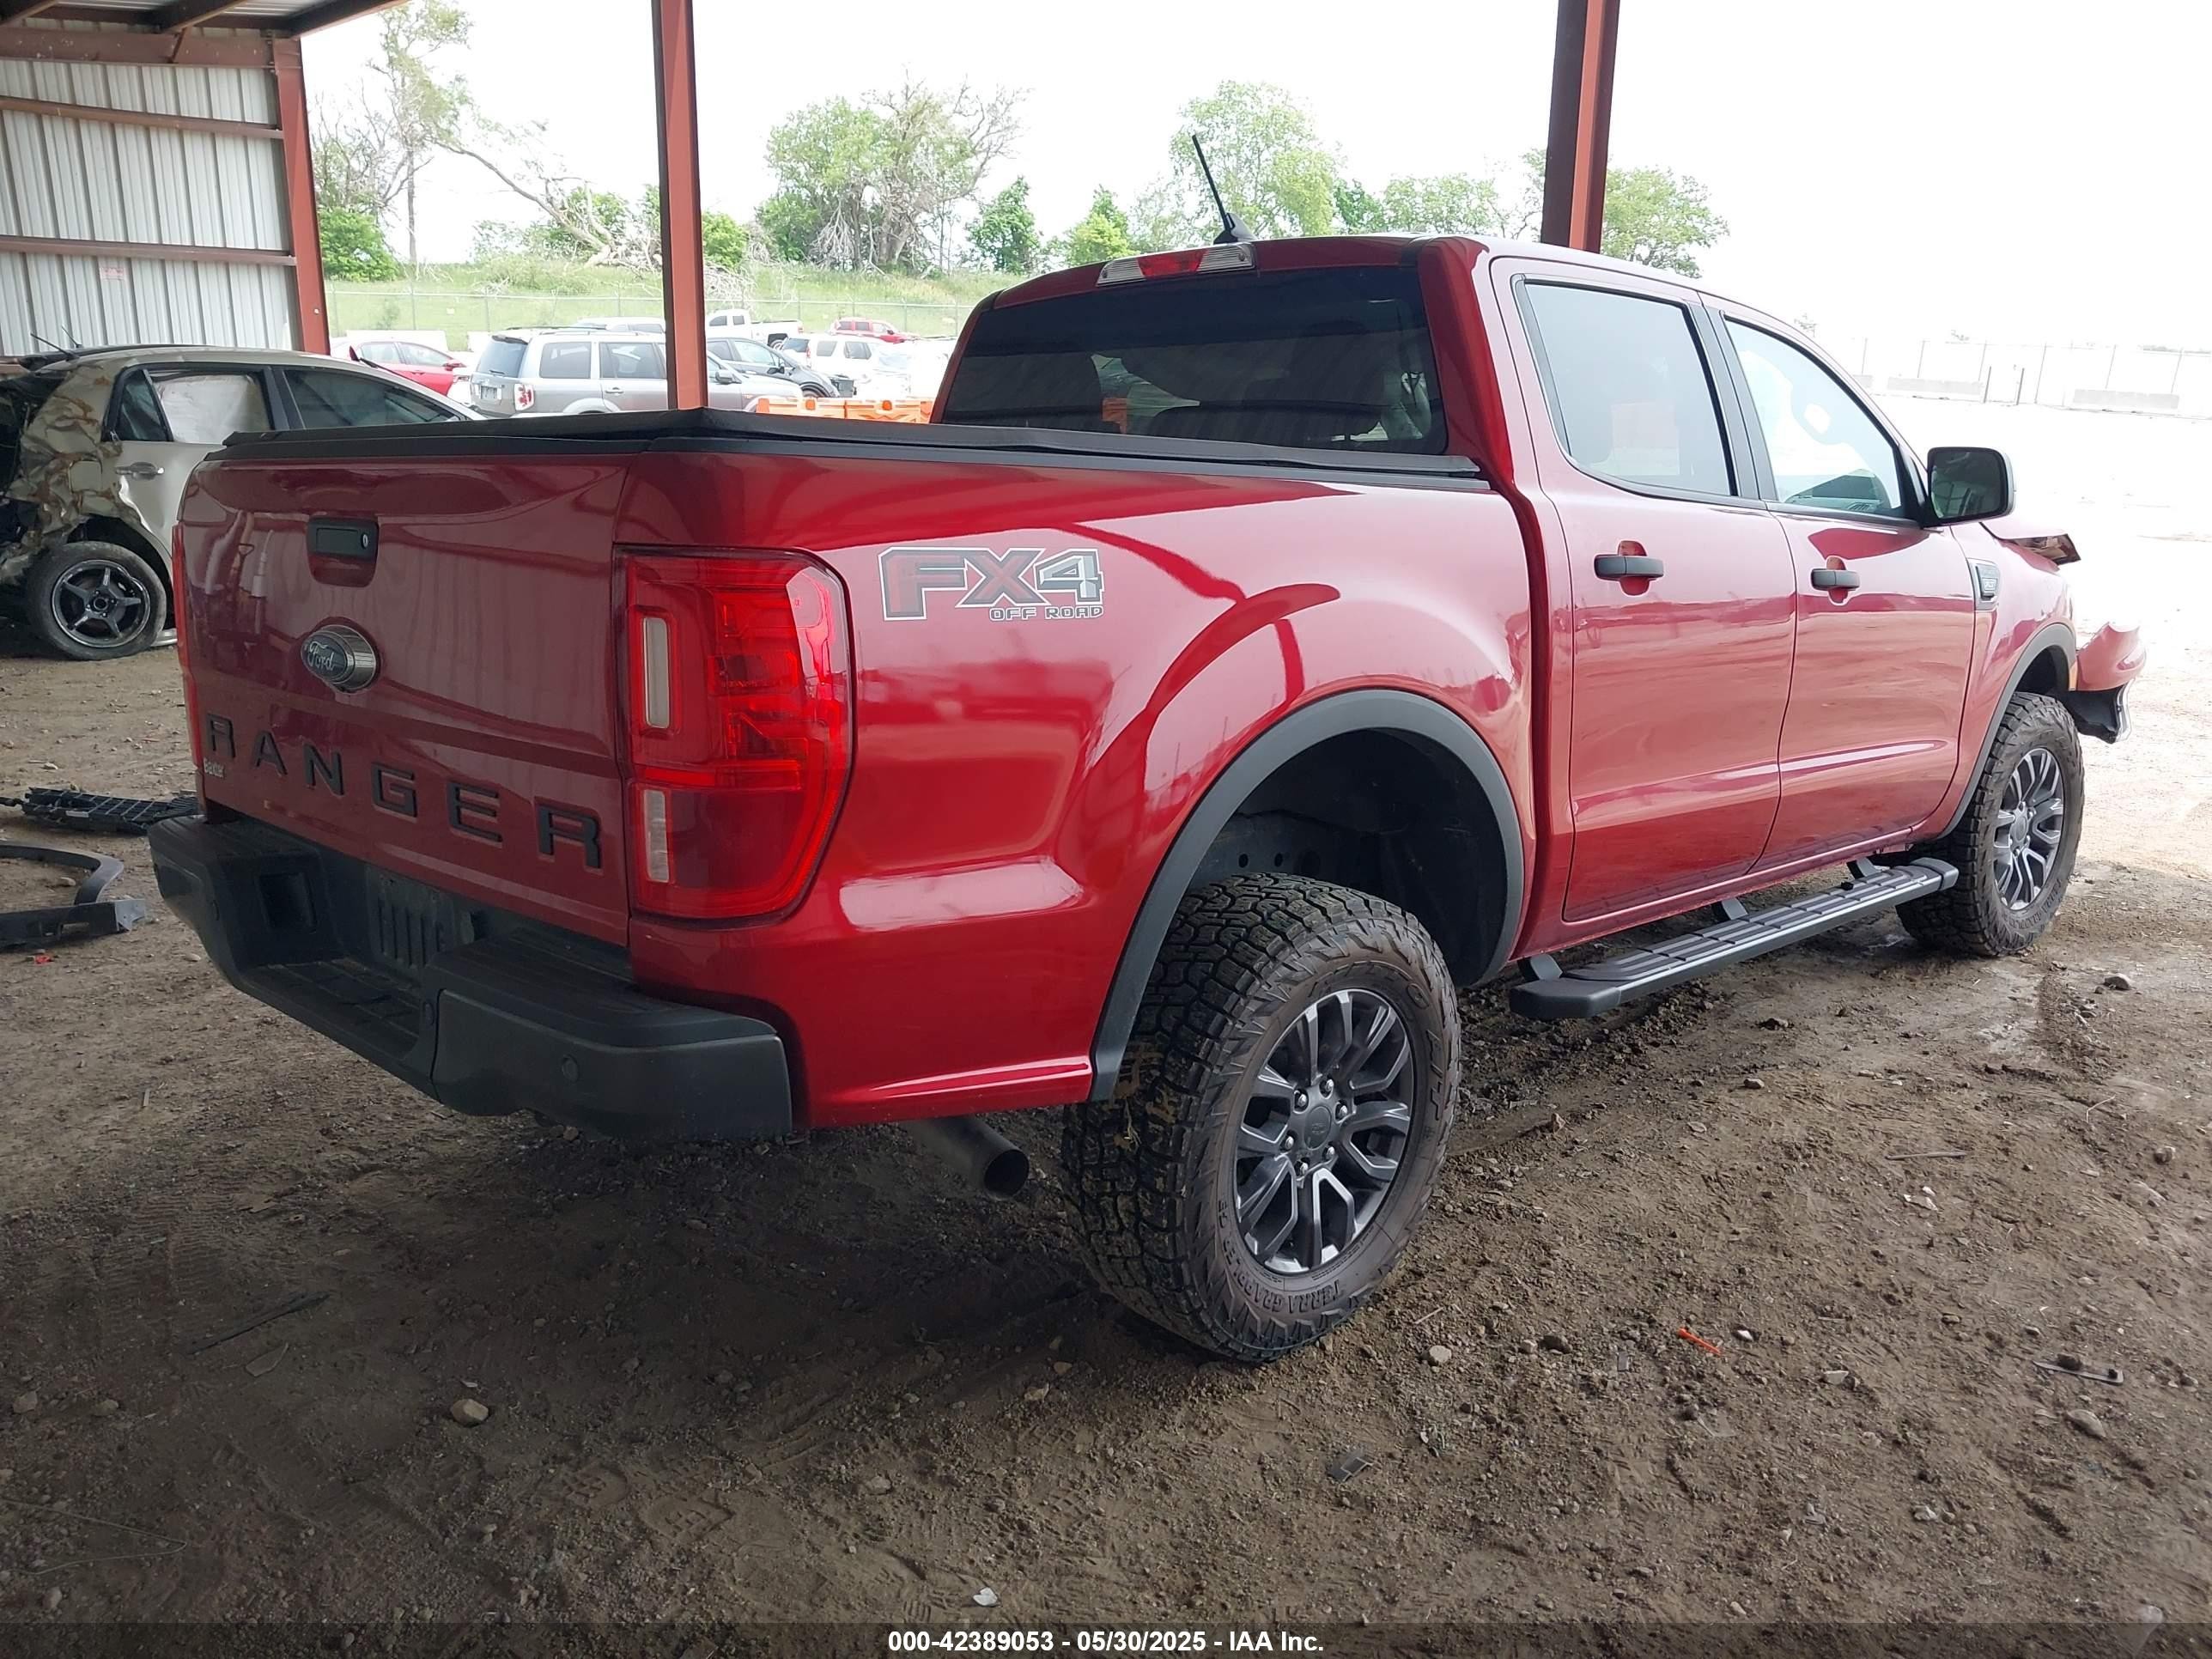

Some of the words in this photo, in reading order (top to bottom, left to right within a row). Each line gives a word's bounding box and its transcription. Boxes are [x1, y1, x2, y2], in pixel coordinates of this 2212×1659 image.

[878, 546, 1104, 620] FX4
[989, 606, 1037, 621] OFF
[1044, 605, 1104, 619] ROAD
[306, 641, 337, 672] Ford
[206, 712, 602, 870] RANGER
